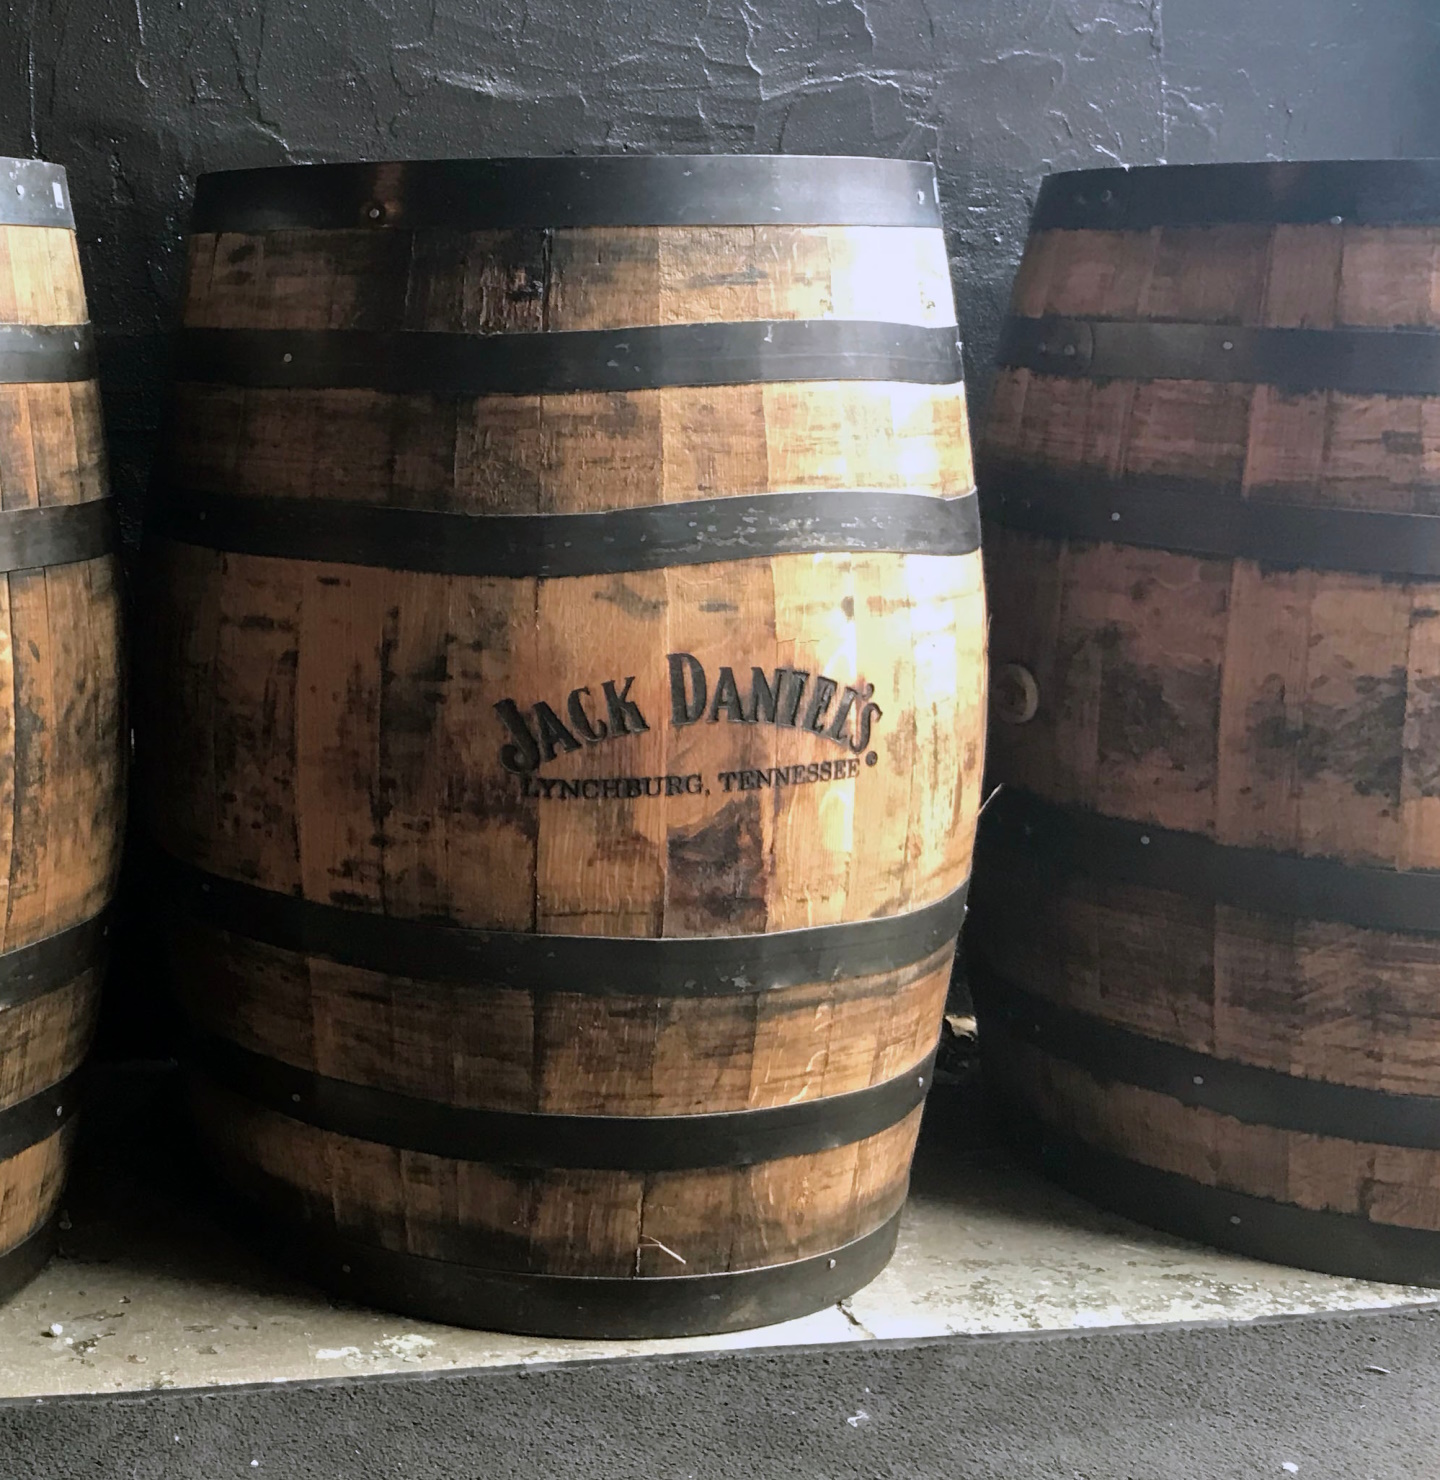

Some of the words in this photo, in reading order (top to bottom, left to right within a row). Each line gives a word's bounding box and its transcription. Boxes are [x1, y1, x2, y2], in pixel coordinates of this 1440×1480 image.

[492, 675, 651, 775] JACK
[666, 651, 883, 754] DANIEL'S
[520, 773, 711, 799] LYNCHBURG,
[718, 758, 860, 792] TENNESSEE
